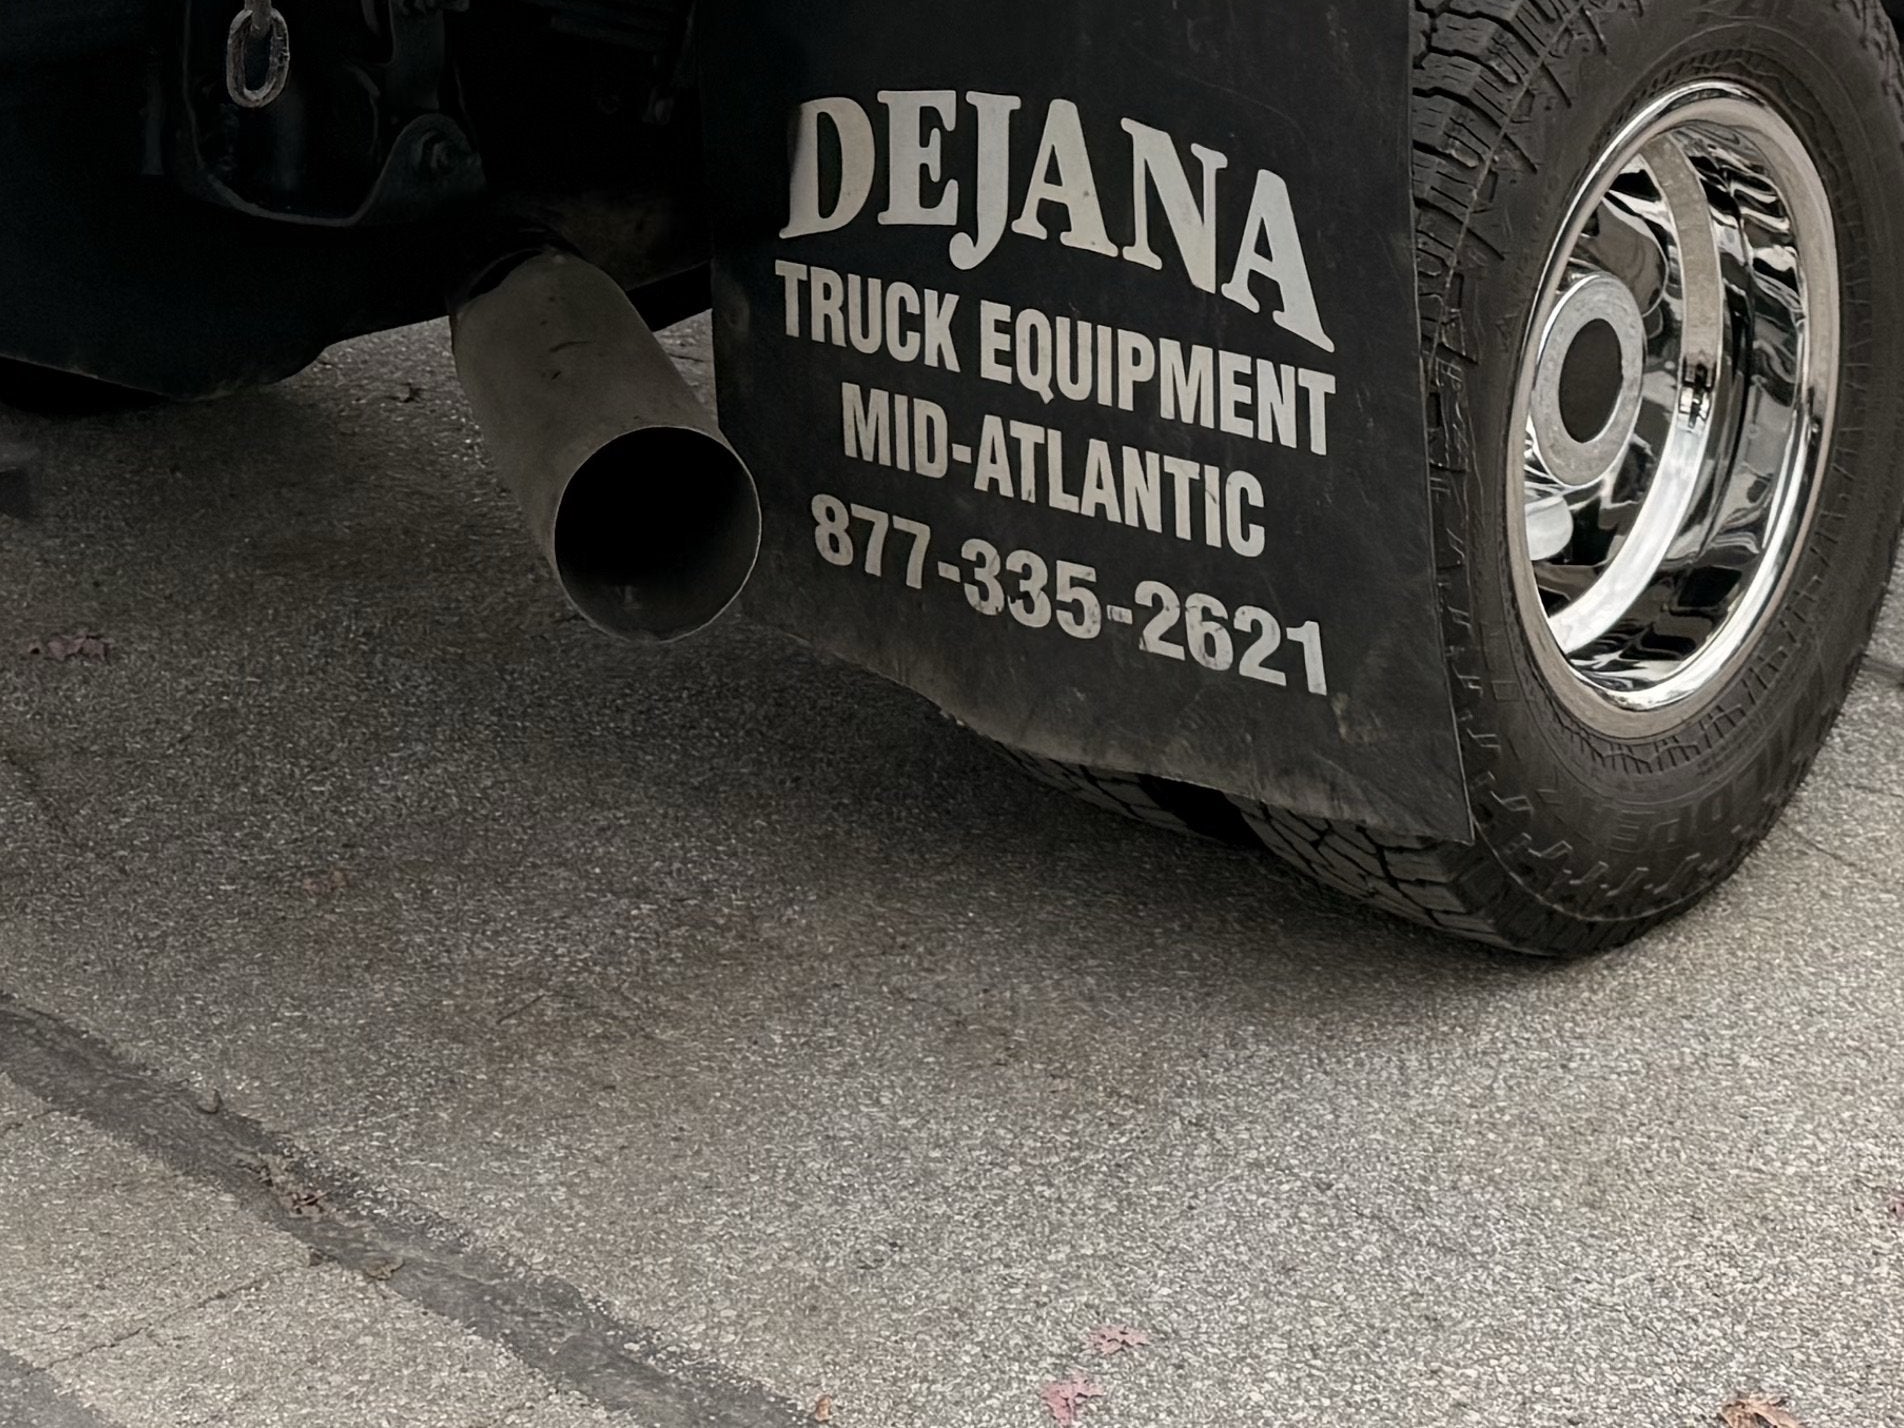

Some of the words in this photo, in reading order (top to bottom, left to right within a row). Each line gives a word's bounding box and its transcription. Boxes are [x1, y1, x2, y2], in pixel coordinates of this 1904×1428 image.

[779, 90, 1335, 352] DEJANA
[774, 259, 960, 373] TRUCK
[979, 299, 1336, 456] EQUIPMENT
[841, 381, 1265, 558] MID-ATLANTIC
[810, 493, 1328, 696] 877-335-2621
